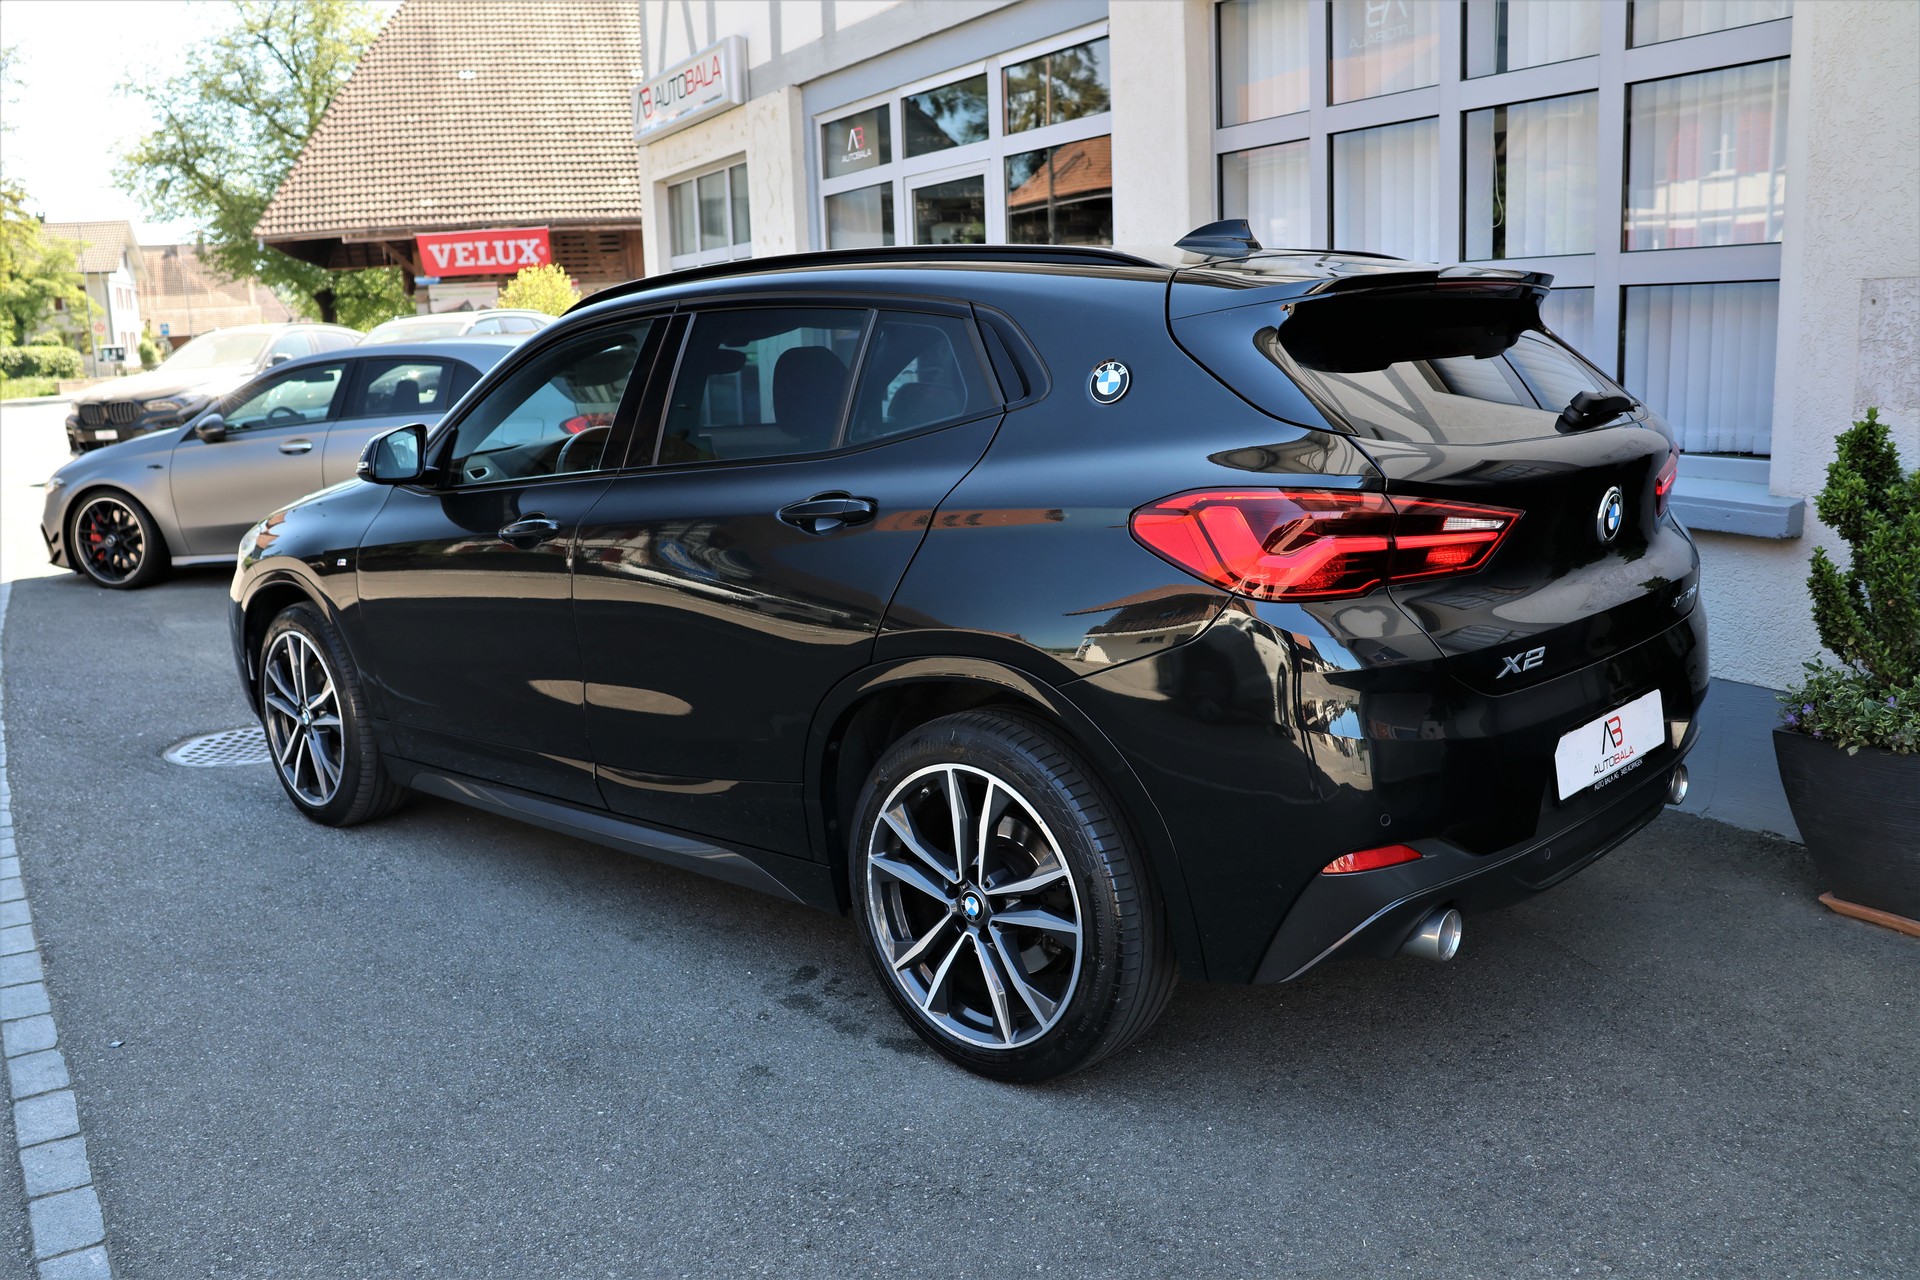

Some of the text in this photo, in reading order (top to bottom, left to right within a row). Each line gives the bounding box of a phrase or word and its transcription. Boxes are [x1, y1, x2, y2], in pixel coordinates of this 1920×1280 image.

[654, 55, 722, 110] AUTOBALA
[1495, 645, 1546, 680] X2
[1601, 715, 1624, 756] AB
[1593, 745, 1635, 777] AUTOBALA
[1594, 779, 1605, 792] AUTO
